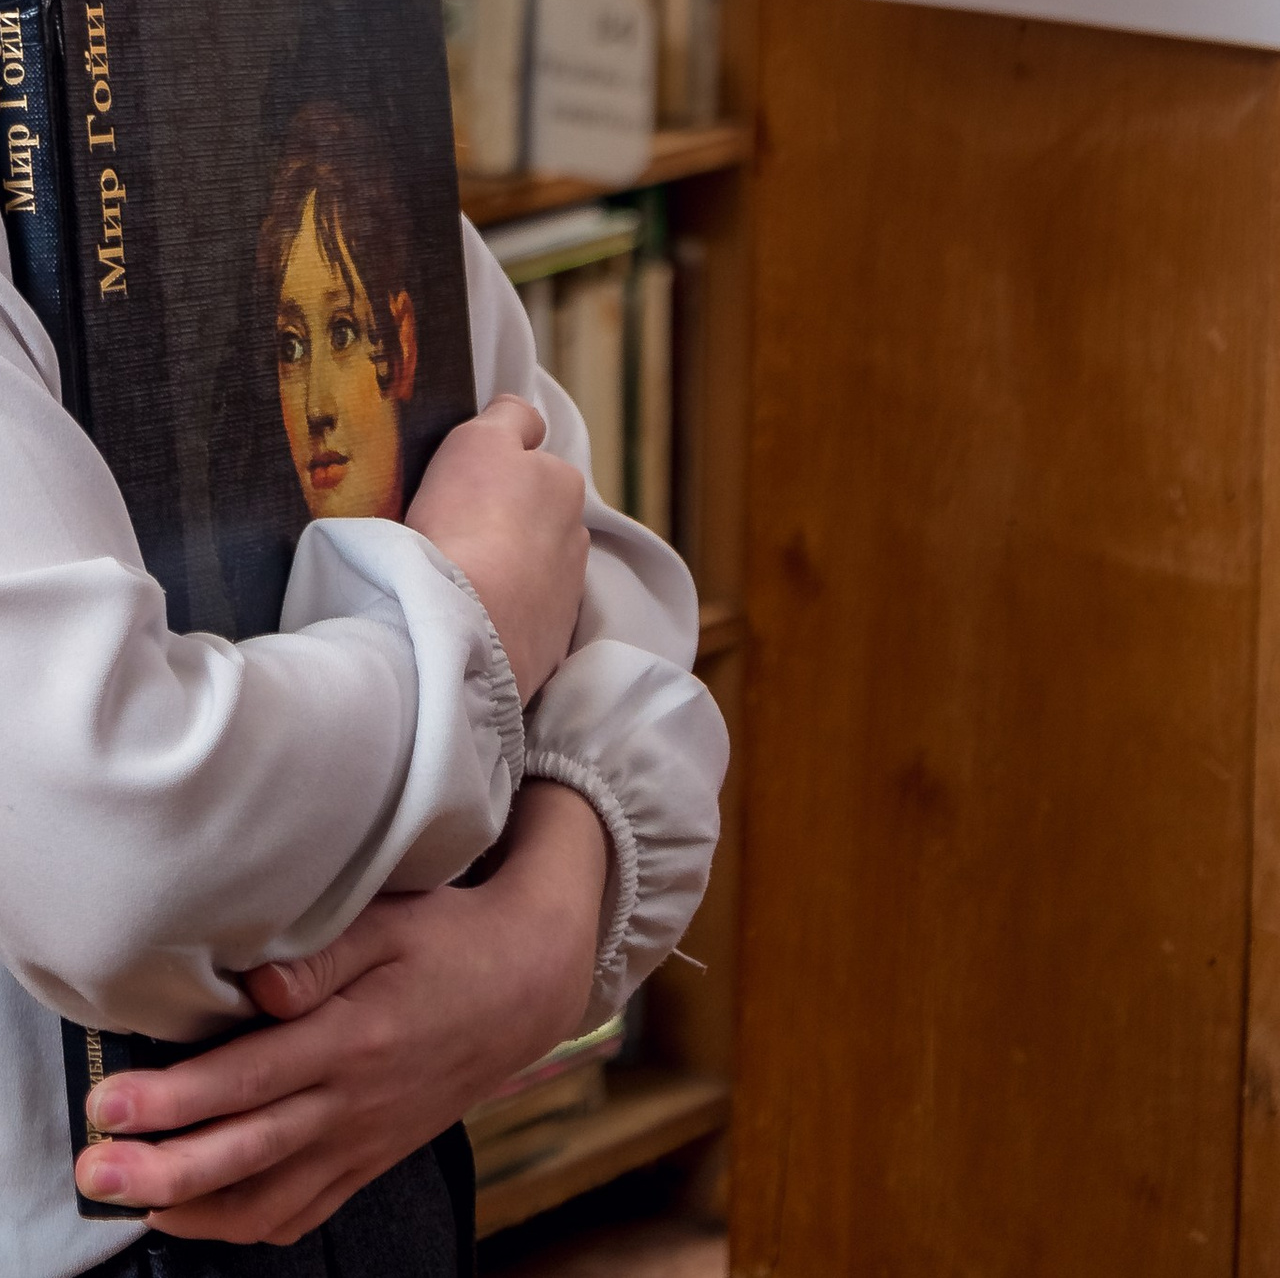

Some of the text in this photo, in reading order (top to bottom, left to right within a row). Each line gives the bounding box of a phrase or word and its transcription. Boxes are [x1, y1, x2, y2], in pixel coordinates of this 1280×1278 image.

[3, 123, 41, 215] Мир
[83, 1, 128, 300] Мир Гойи
